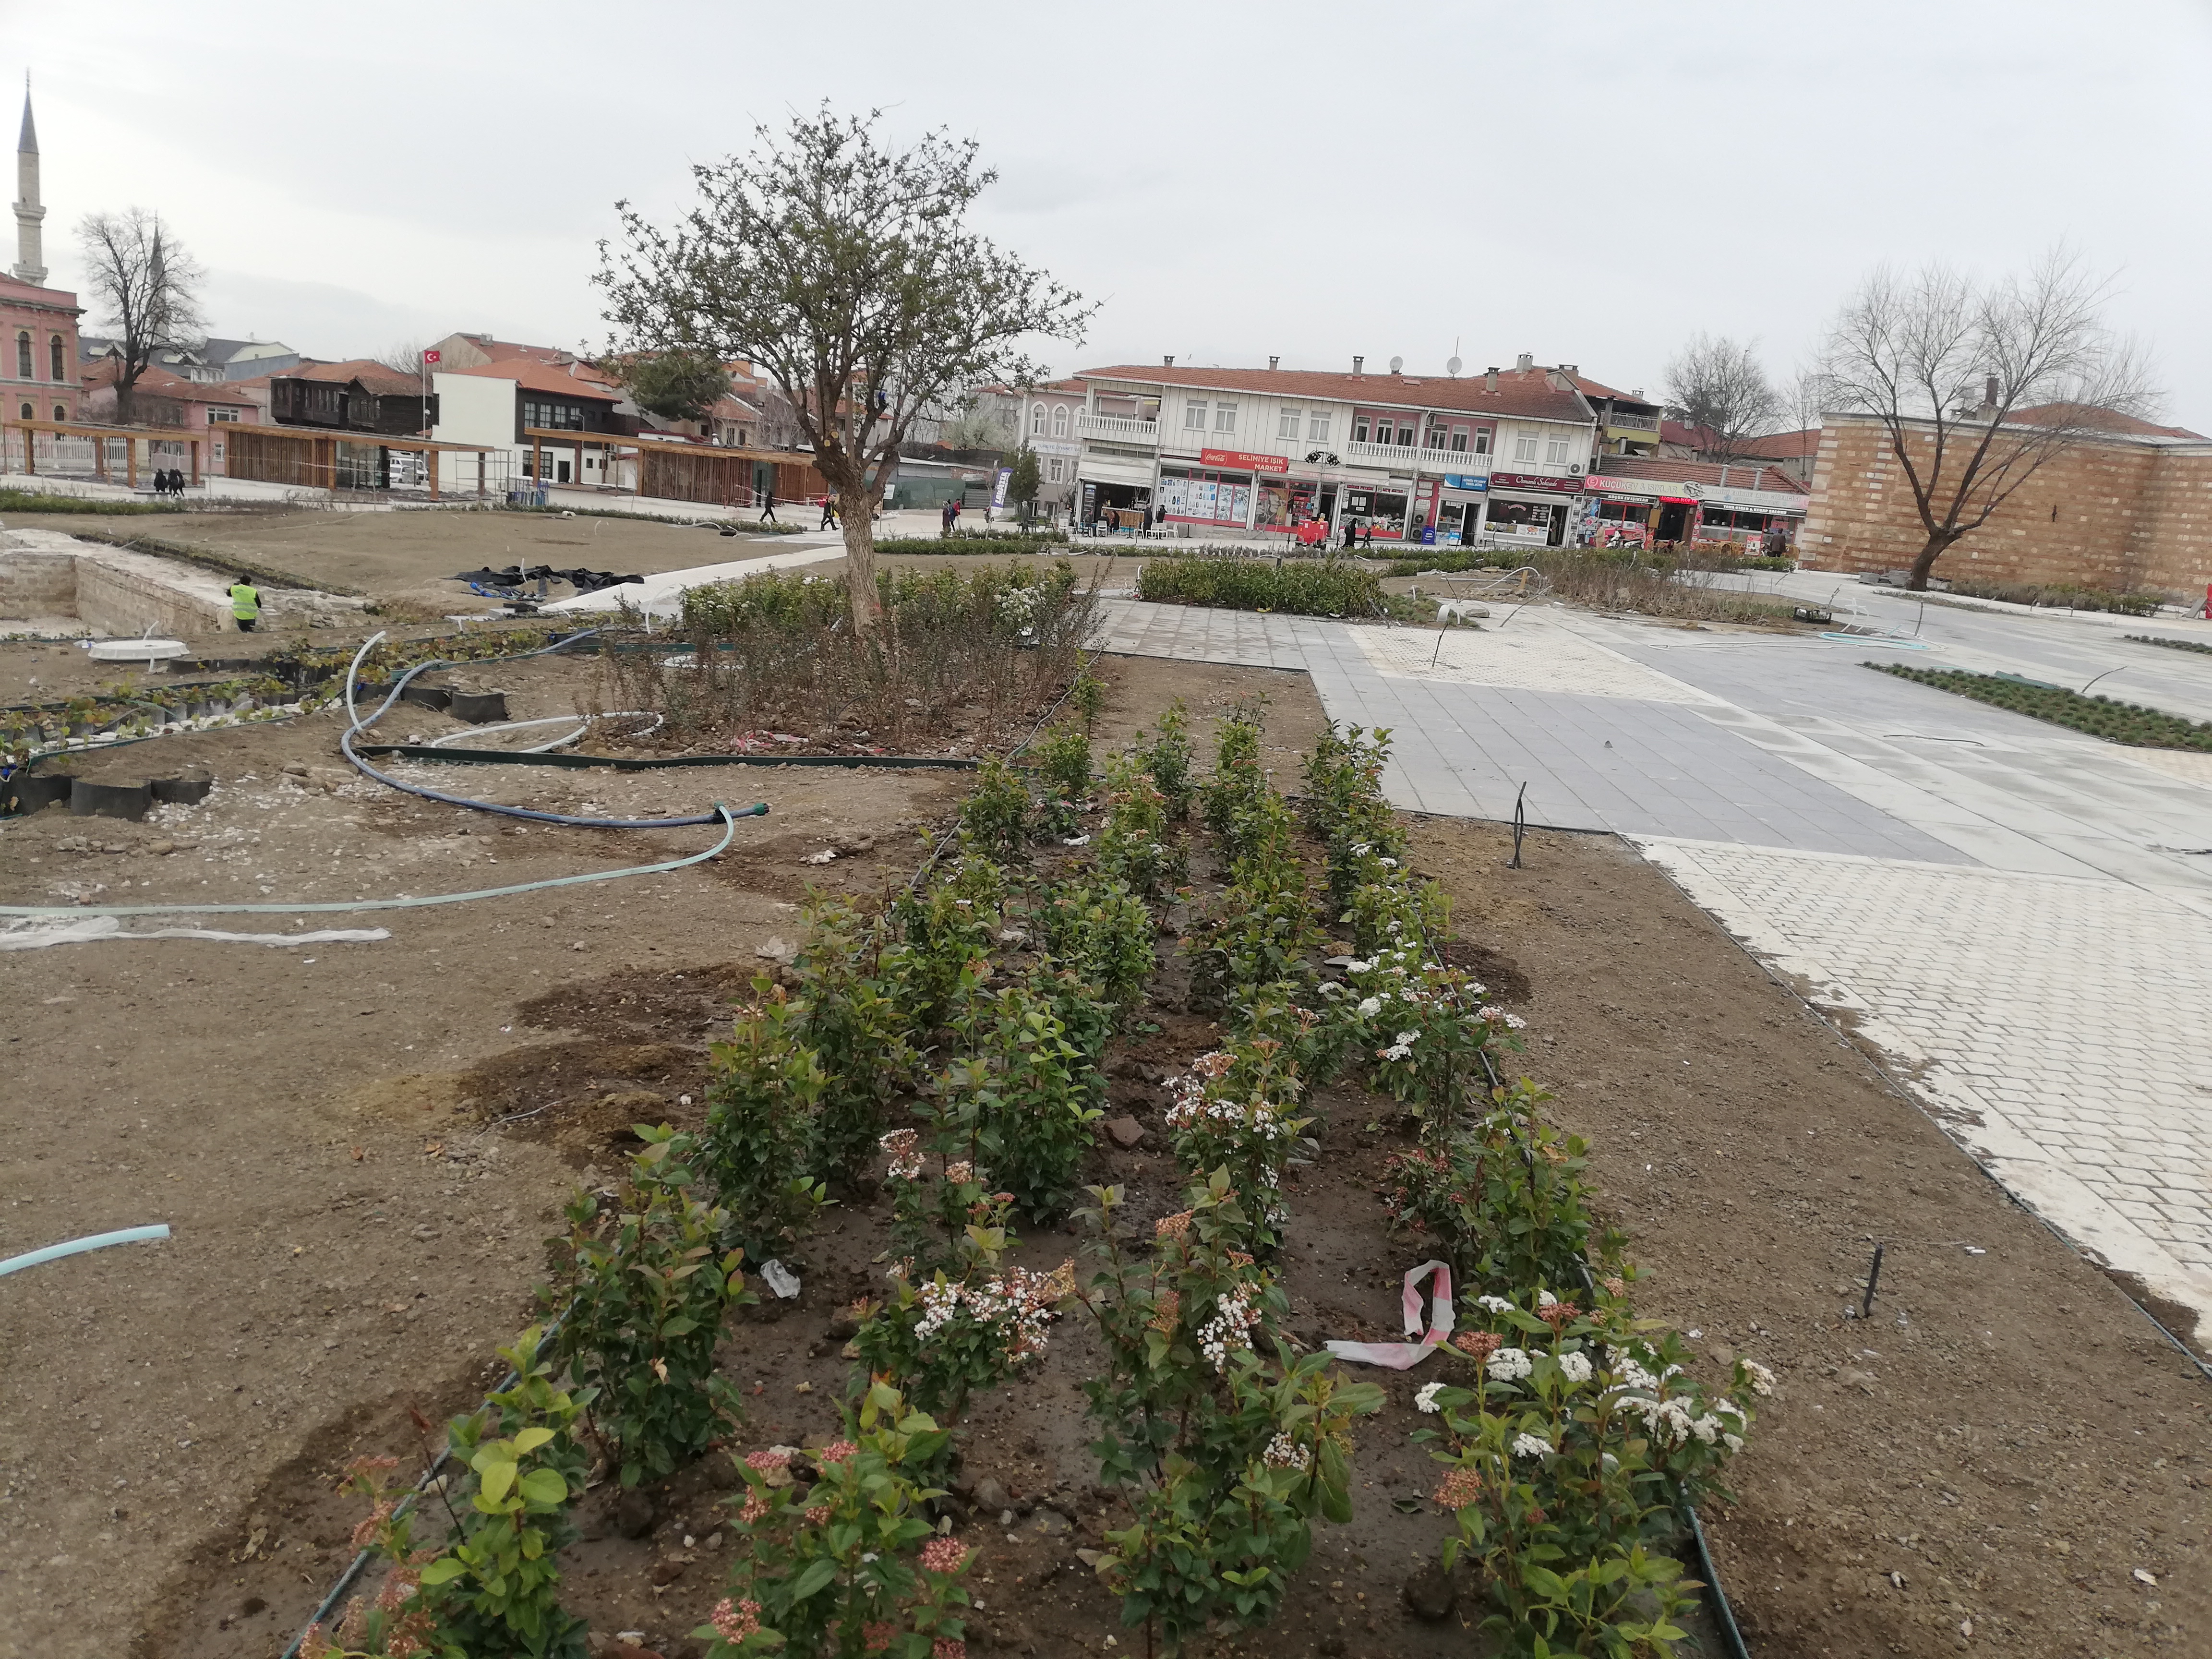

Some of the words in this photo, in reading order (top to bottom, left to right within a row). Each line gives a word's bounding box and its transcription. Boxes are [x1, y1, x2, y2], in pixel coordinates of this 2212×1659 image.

[1238, 454, 1269, 463] SELİMİYE
[1254, 464, 1283, 472] MARKET
[1599, 479, 1638, 491] KÜÇÜKEV
[1647, 484, 1677, 494] IŞIKLAR
